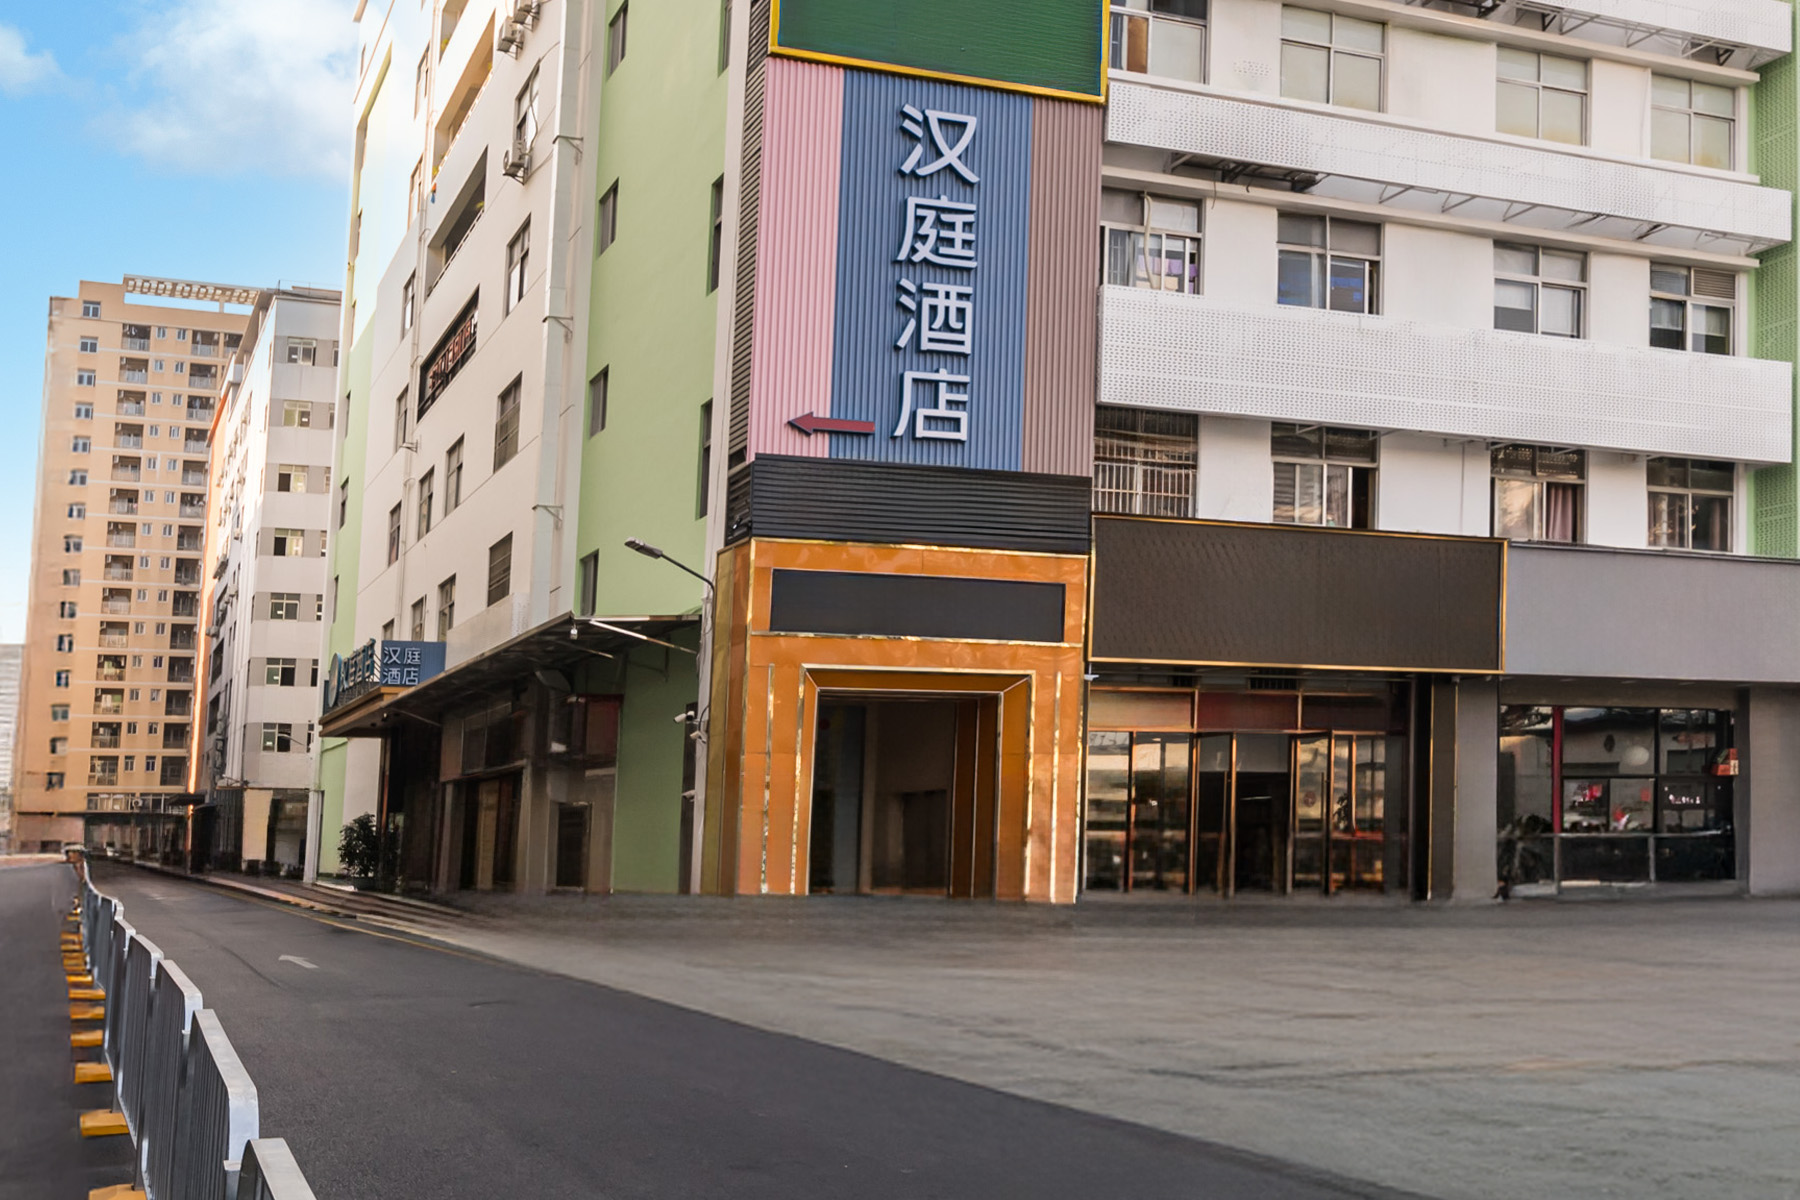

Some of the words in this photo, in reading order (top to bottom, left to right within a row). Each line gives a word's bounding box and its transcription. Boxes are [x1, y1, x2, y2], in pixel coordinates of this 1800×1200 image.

[891, 103, 981, 443] 汉庭酒店
[383, 646, 422, 665] 汉庭
[382, 667, 420, 686] 酒店
